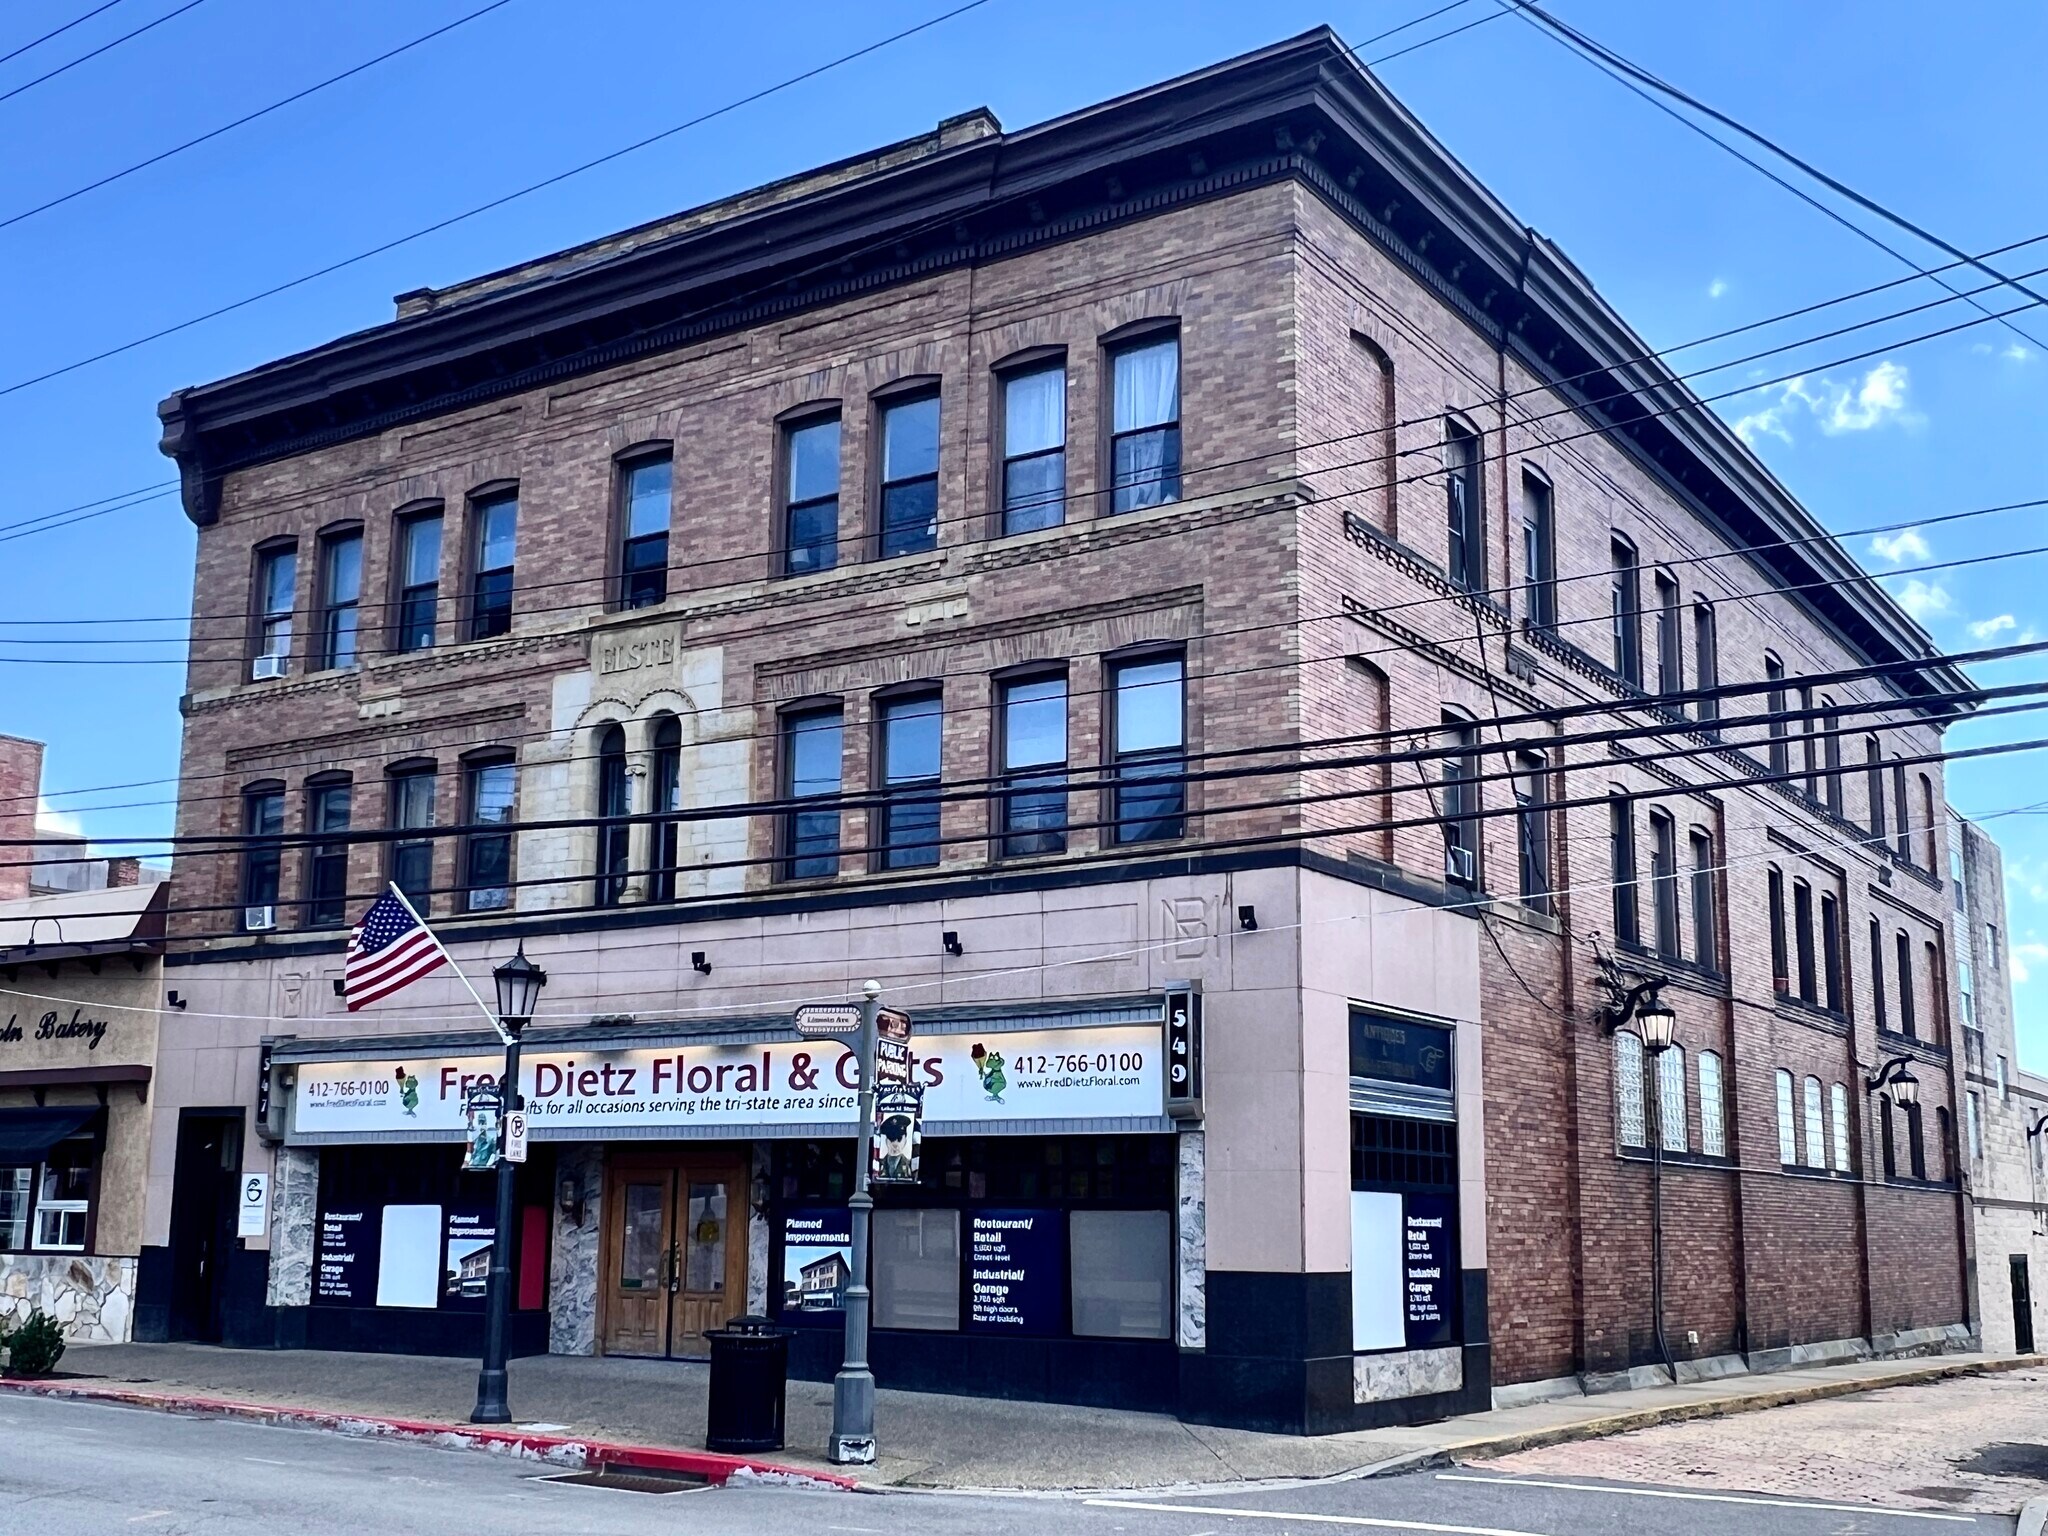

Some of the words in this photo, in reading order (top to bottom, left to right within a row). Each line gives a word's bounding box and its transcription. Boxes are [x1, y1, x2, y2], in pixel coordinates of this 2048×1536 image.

[35, 1009, 108, 1050] Bakery
[1014, 1052, 1143, 1074] 412-766-0100
[535, 1061, 637, 1098] Dietz
[652, 1052, 771, 1094] Floral
[788, 1053, 820, 1091] &
[835, 1051, 944, 1091] Gts
[1017, 1075, 1140, 1088] www.FredDietzFloral.com
[308, 1080, 389, 1097] 412-766-0100
[546, 1099, 565, 1115] for
[568, 1099, 583, 1114] all
[585, 1098, 645, 1114] occasions
[648, 1097, 695, 1115] serving
[700, 1097, 720, 1111] the
[725, 1095, 780, 1110] tri-state
[784, 1097, 814, 1109] area
[818, 1094, 855, 1108] since
[786, 1218, 823, 1229] Planned
[973, 1218, 1034, 1230] Restaurant/
[785, 1232, 850, 1244] Improvements
[973, 1231, 1002, 1243] Retail
[973, 1268, 1025, 1281] Industrial/
[973, 1283, 1009, 1296] Garage
